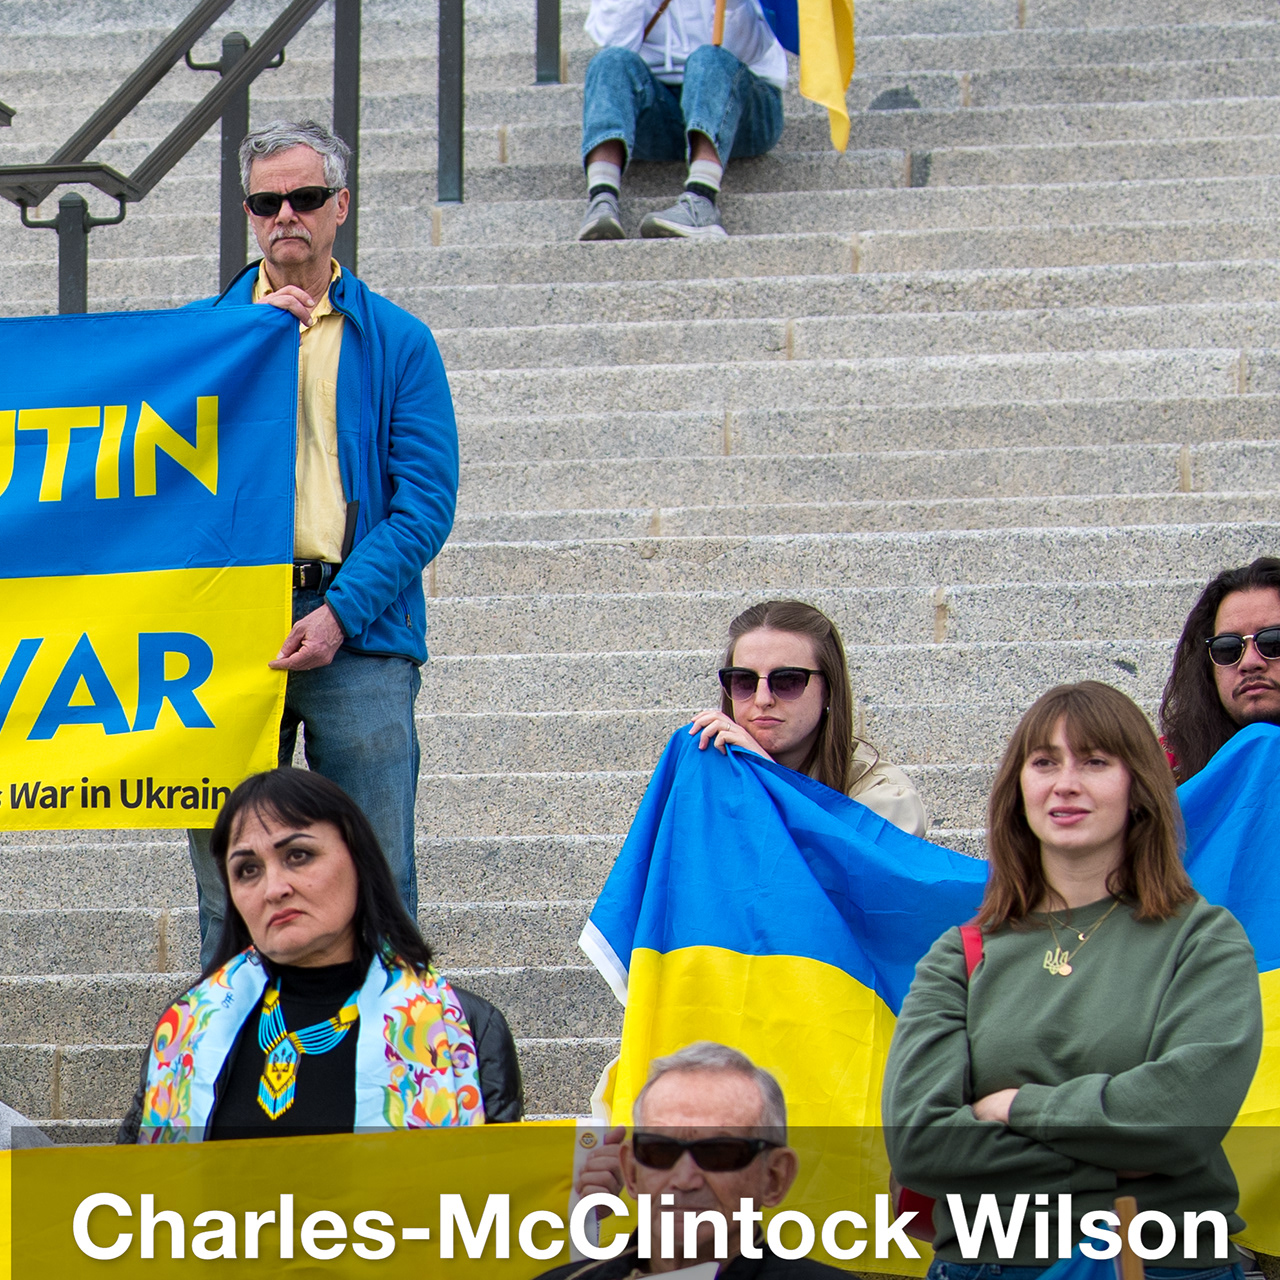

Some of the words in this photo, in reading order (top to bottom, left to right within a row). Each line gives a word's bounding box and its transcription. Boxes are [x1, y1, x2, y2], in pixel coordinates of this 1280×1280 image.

[10, 780, 75, 811] War
[80, 776, 111, 809] in
[119, 777, 231, 811] Ukrain
